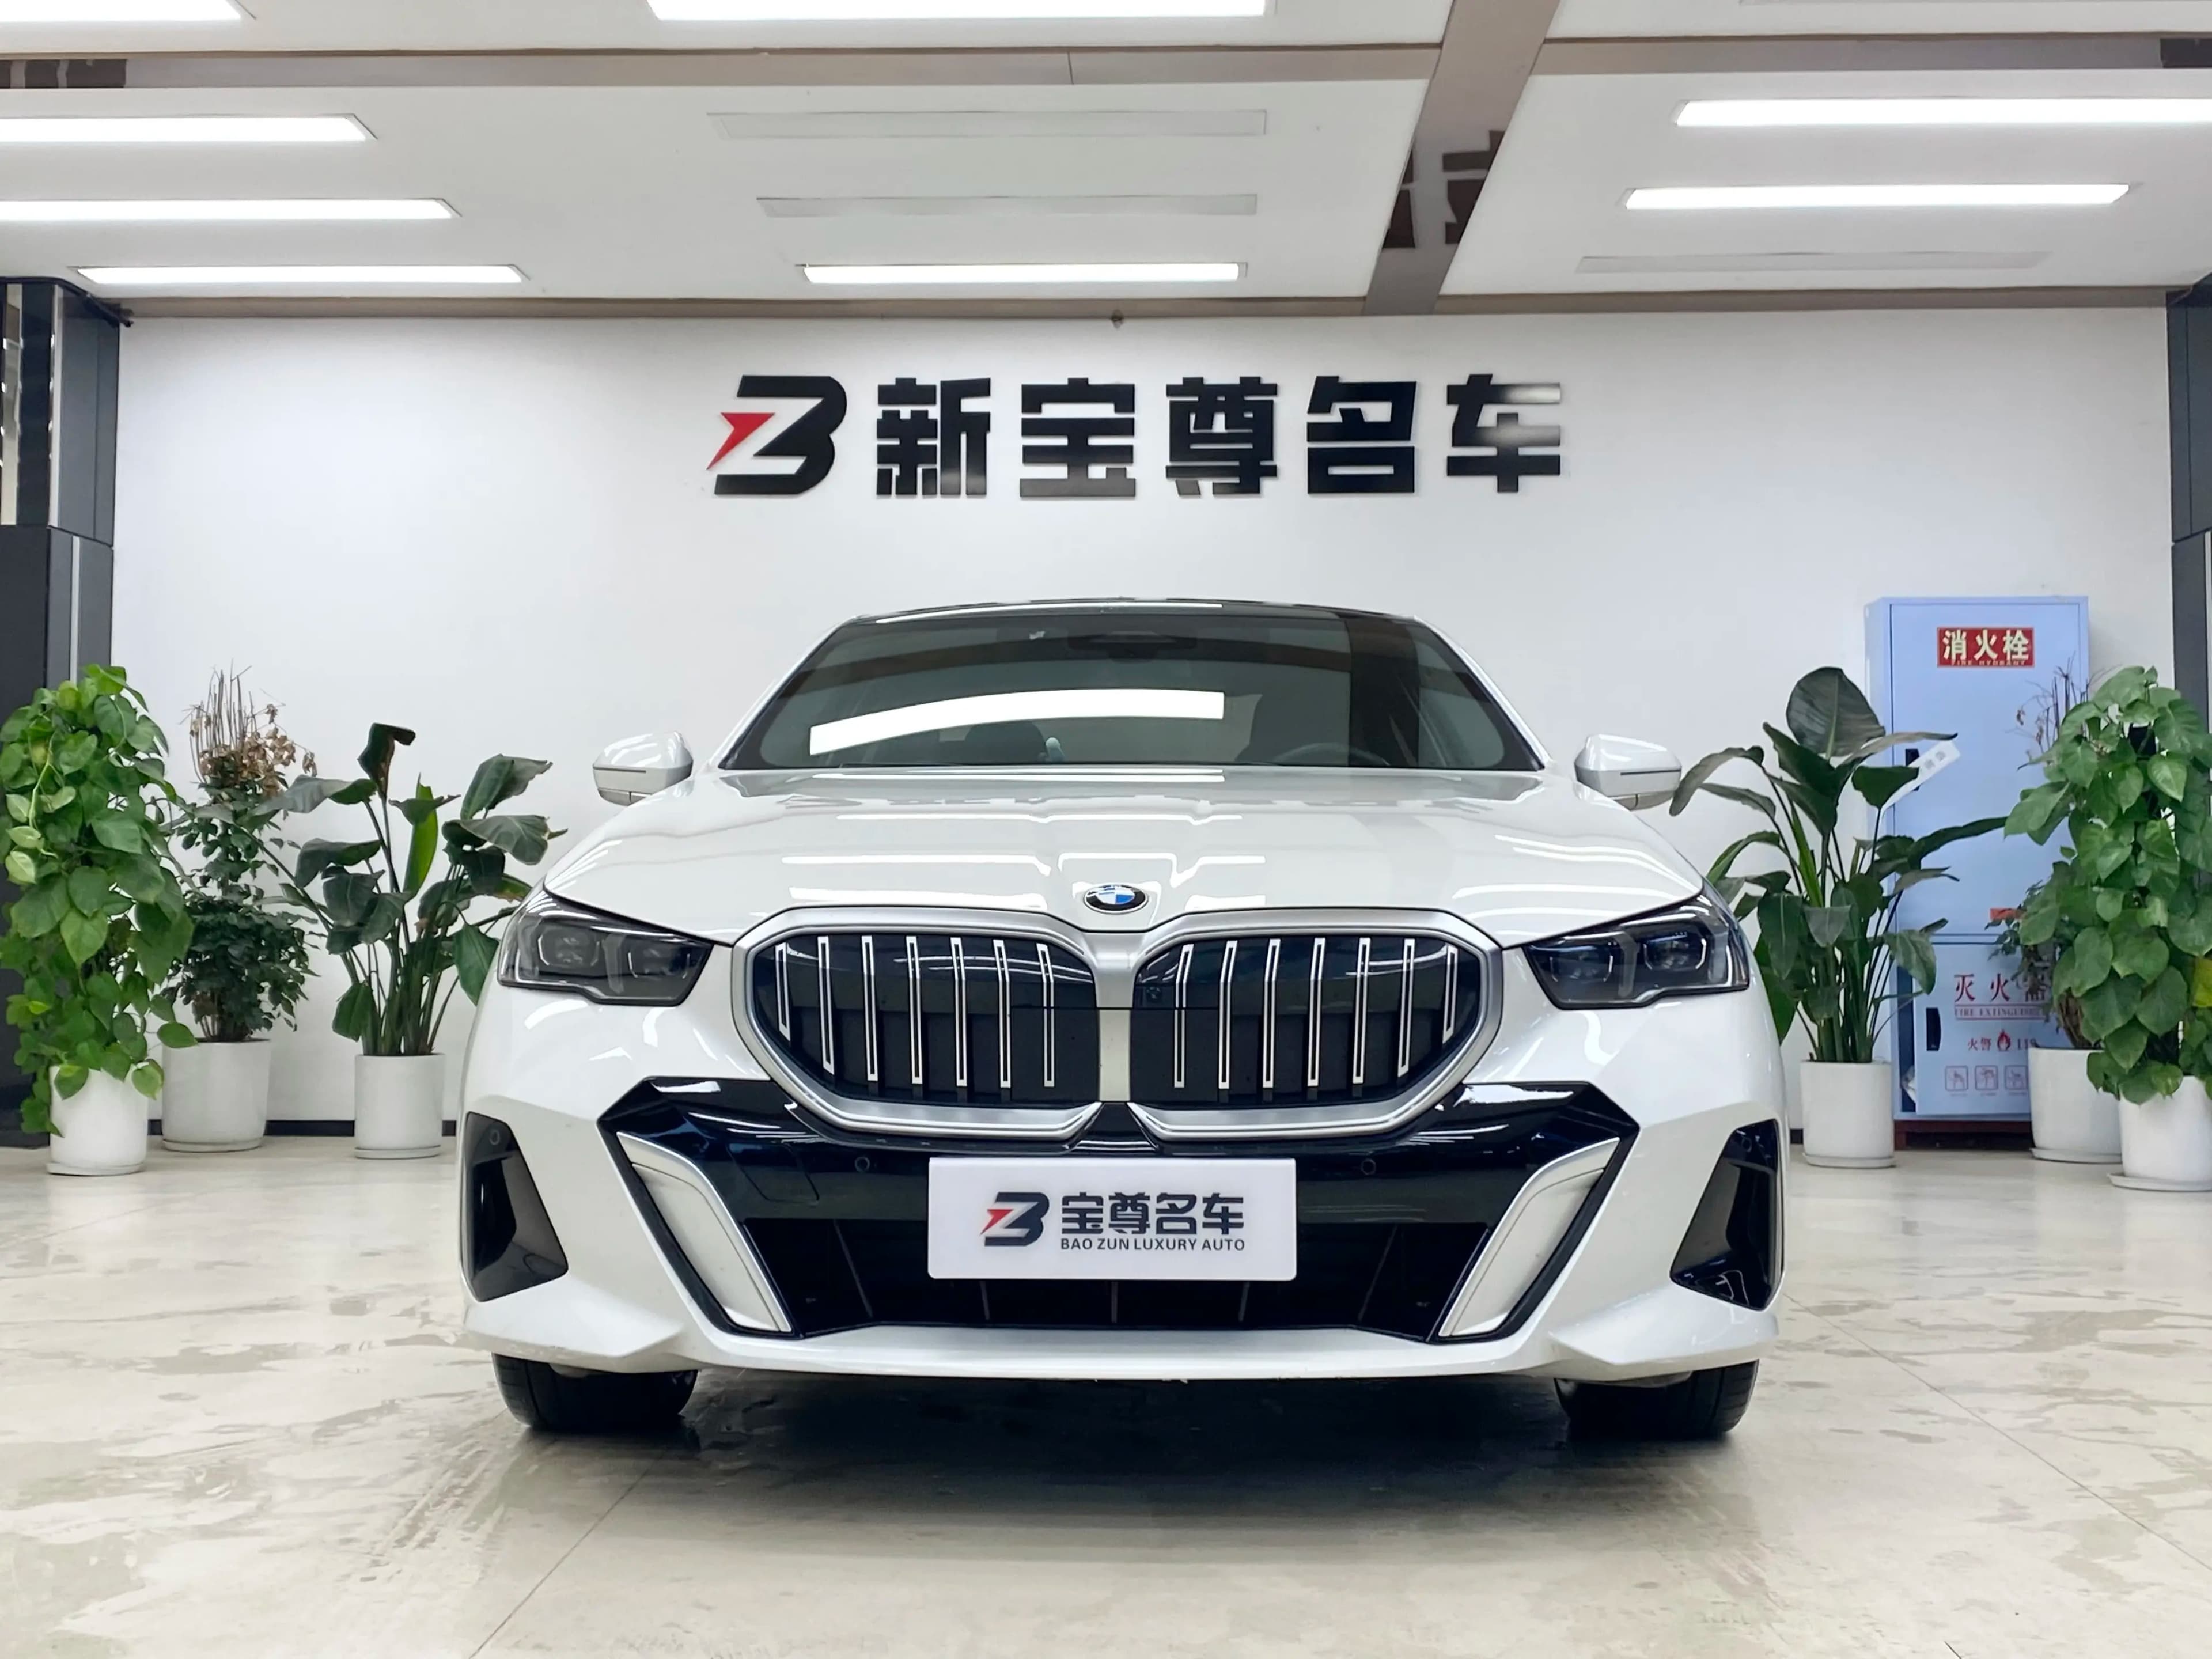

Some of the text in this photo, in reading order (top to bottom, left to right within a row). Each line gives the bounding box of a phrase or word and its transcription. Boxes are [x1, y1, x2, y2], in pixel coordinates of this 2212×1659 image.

[876, 373, 1561, 498] 新宝尊名车
[1942, 629, 2029, 661] 消火栓
[1968, 1037, 1991, 1051] 火警
[1061, 1192, 1244, 1235] 宝尊名车
[1060, 1238, 1245, 1251] BAO ZUN LUXURY AUTO
